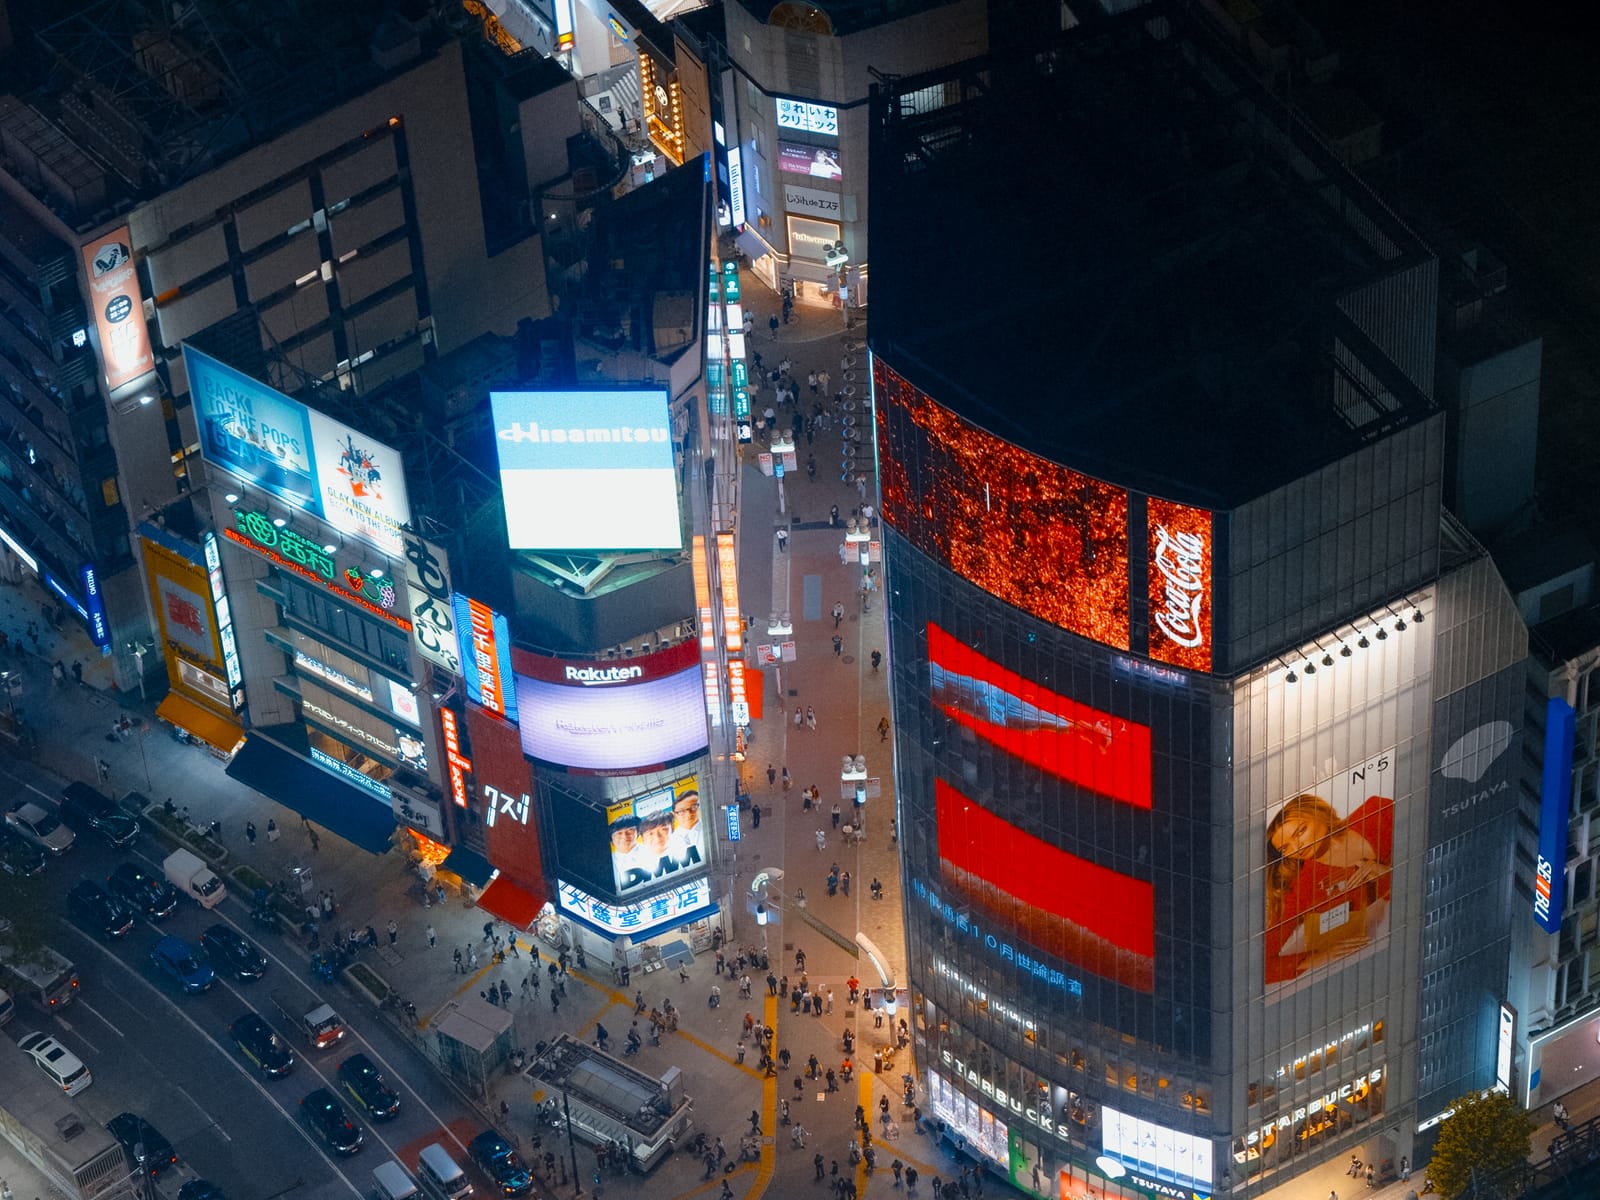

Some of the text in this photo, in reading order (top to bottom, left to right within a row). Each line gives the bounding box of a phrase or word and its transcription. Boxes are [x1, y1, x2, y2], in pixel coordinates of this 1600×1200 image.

[780, 113, 837, 131] クリニック
[793, 103, 837, 120] れいわ
[261, 422, 300, 455] POPS
[497, 422, 668, 443] Hisamitsu
[351, 497, 373, 517] NEW
[280, 534, 335, 579] 西村
[470, 606, 500, 713] 三千里薬品
[565, 665, 643, 681] Rakuten
[1441, 780, 1509, 820] TSUTAYA
[1534, 854, 1552, 922] SEIBU
[568, 886, 699, 928] 大盛堂書店
[942, 1049, 1070, 1138] STARBUCKS
[1247, 1068, 1382, 1145] STARBUCKS
[1131, 1176, 1186, 1200] TSUTAYA
